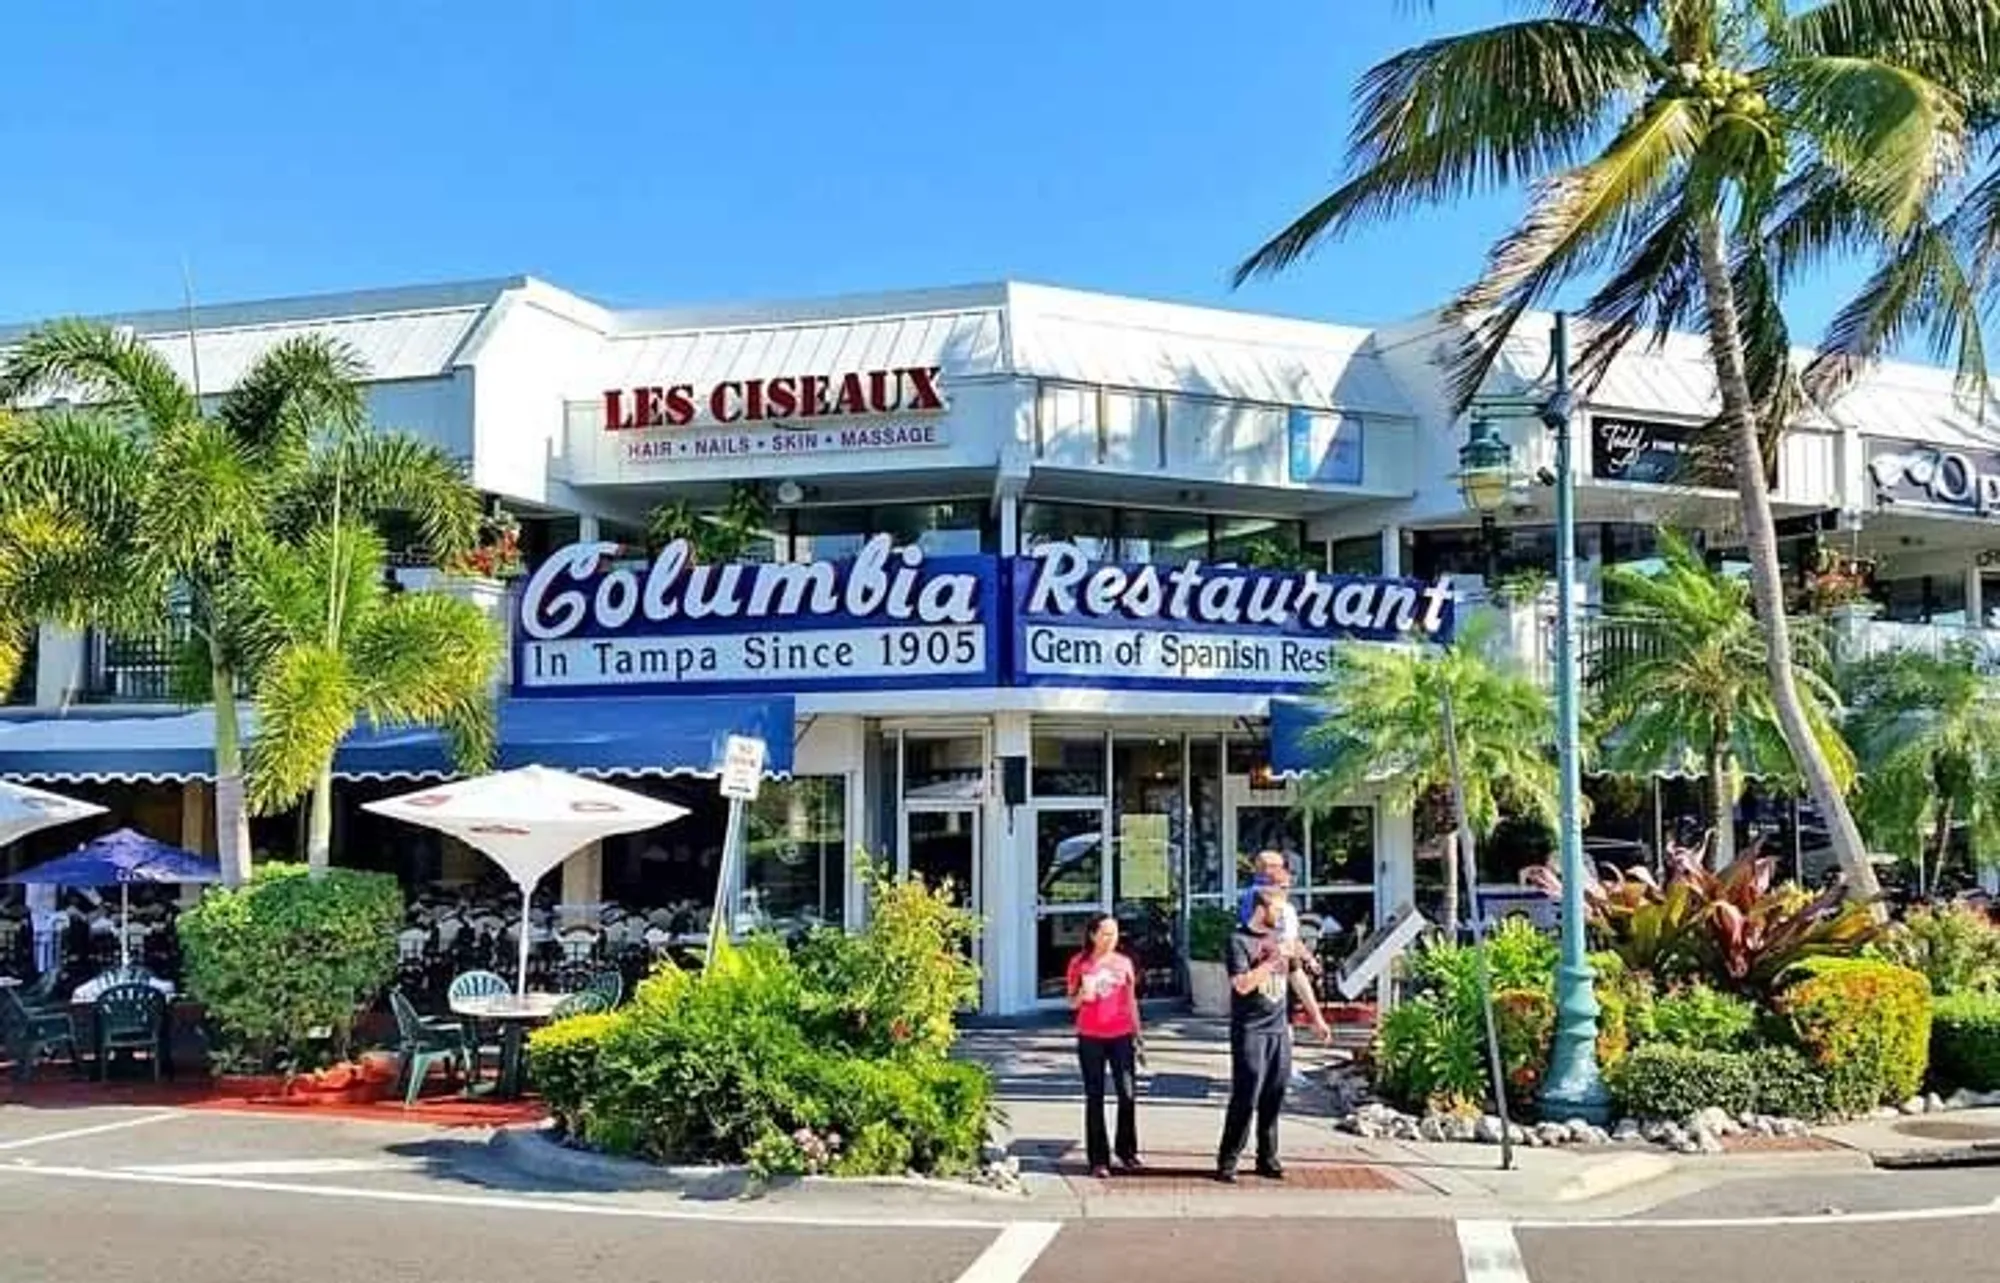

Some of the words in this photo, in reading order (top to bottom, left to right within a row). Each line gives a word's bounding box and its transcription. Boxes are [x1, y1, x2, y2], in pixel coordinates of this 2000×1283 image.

[603, 382, 696, 431] LES
[709, 365, 945, 425] CISEAUX
[627, 442, 672, 459] HAIR
[695, 436, 750, 456] NAILS
[771, 433, 818, 451] SKIN
[840, 426, 936, 447] MASSAGE
[520, 532, 979, 640] Columbia
[1026, 541, 1455, 635] Restaurant
[534, 645, 568, 677] In
[593, 641, 718, 681] Tampa
[743, 636, 854, 669] Since
[879, 630, 978, 667] 1905
[1031, 629, 1101, 665] Gem
[1116, 630, 1144, 666] of
[1160, 634, 1271, 676] Spanish
